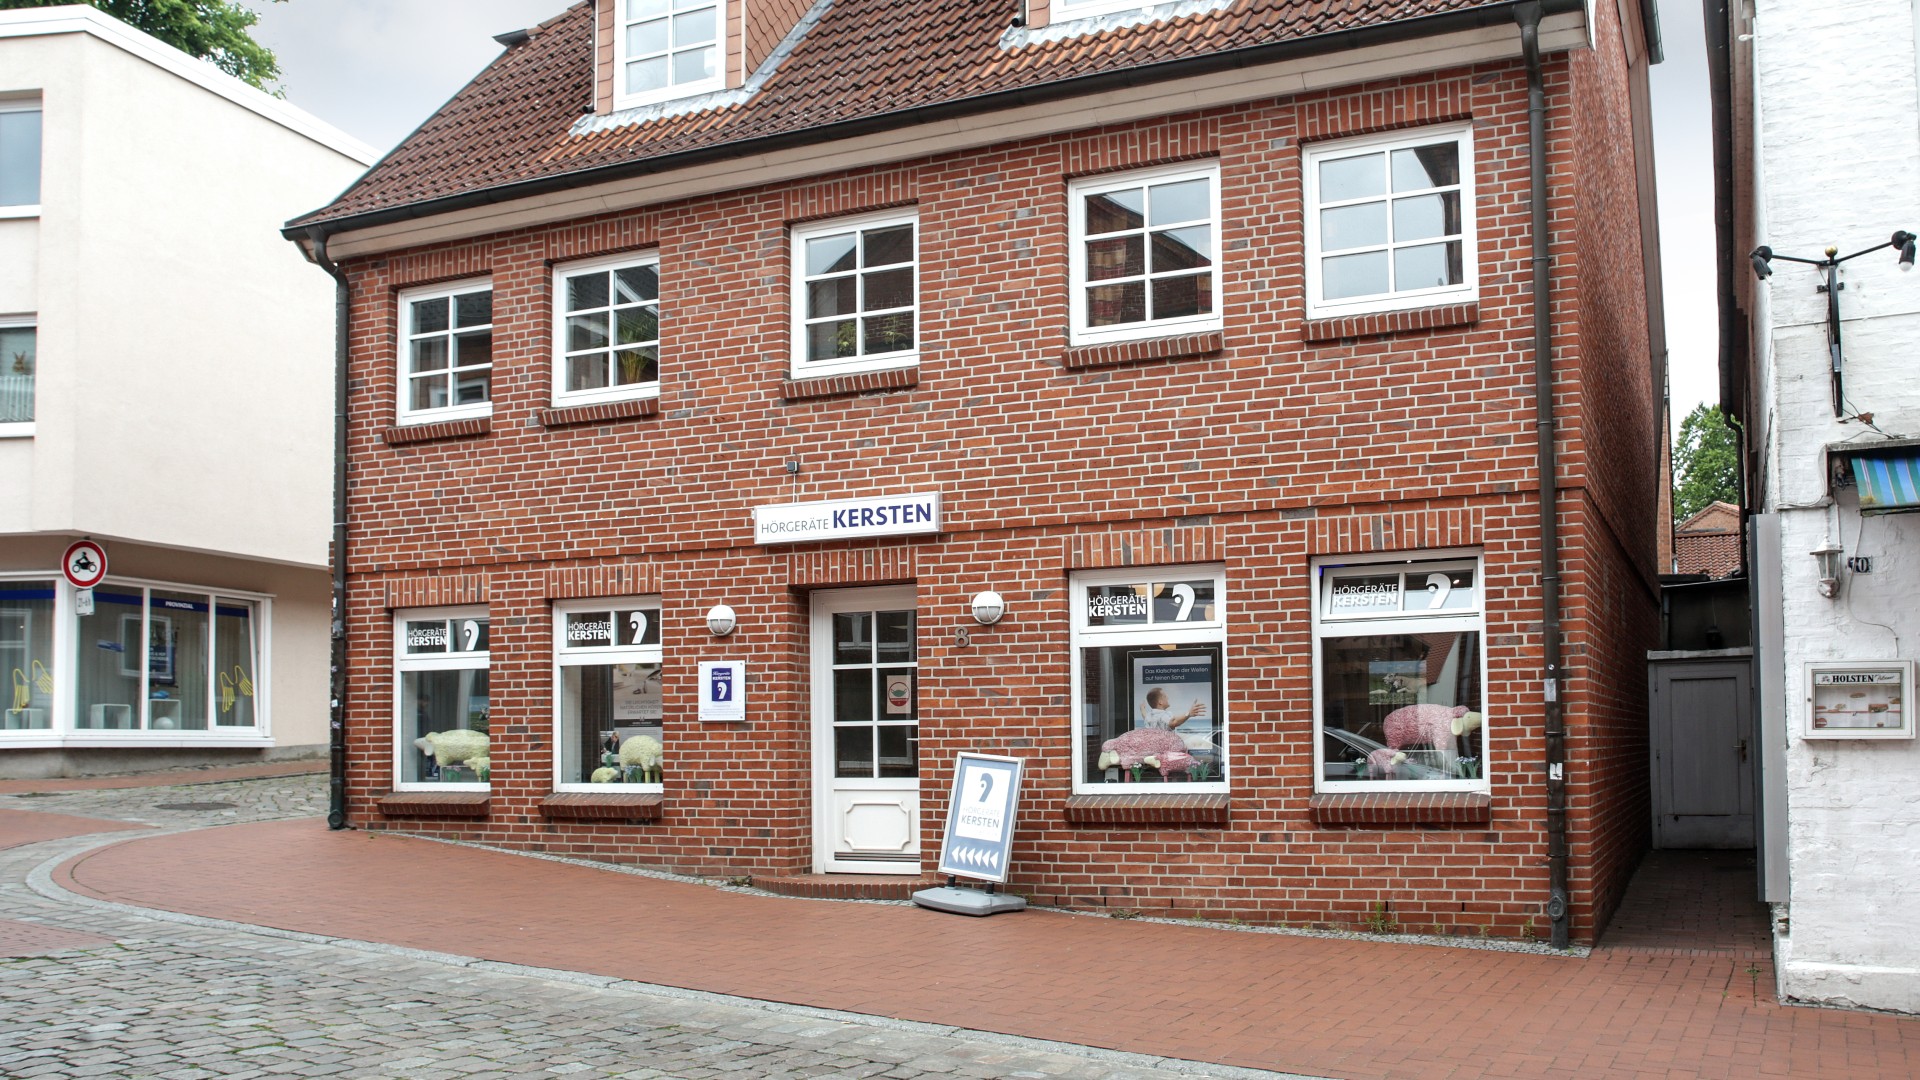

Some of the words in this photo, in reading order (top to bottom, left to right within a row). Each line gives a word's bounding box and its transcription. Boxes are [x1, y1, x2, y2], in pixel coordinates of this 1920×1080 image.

[761, 517, 829, 533] HÖRGERÄTE
[833, 503, 931, 528] KERSTEN
[1333, 583, 1397, 595] HÖRGERÄTE
[1088, 594, 1146, 605] HÖRGERÄTE
[1333, 593, 1398, 607] KERSTEN
[1088, 603, 1146, 617] KERSTEN
[568, 621, 611, 631] HÖRGERÄTE
[408, 628, 447, 637] HÖRGERÄTE
[568, 630, 611, 640] KERSTEN
[955, 626, 969, 648] 8
[408, 636, 447, 646] KERSTEN
[1832, 674, 1874, 683] HOLSTEN
[961, 814, 1000, 828] KERSTEN
